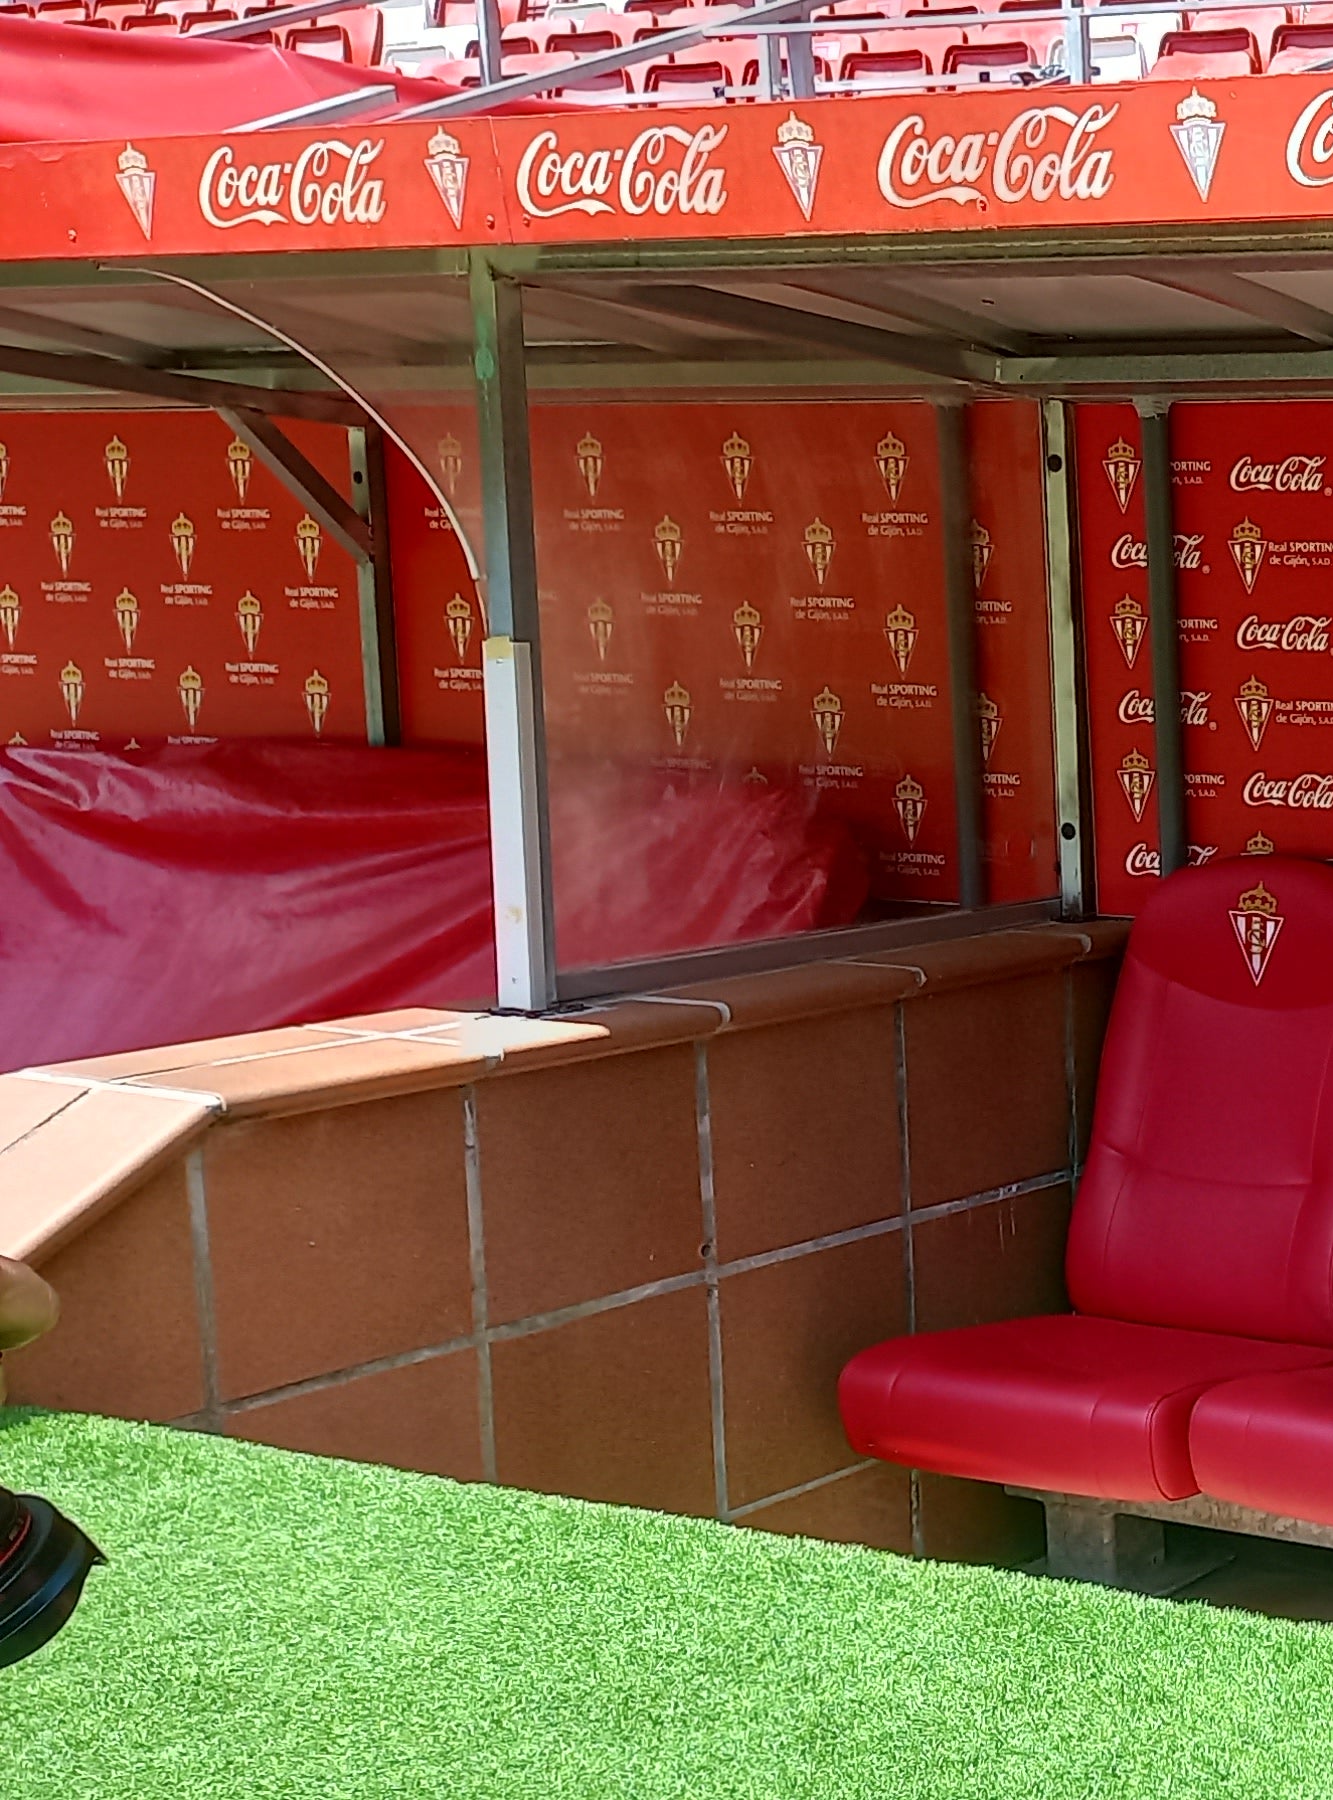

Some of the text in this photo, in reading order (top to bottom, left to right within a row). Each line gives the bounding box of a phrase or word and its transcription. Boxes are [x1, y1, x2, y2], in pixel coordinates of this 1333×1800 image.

[517, 123, 729, 217] Coca-Cola
[876, 101, 1121, 208] Coca-Cola
[200, 138, 387, 228] Coca-Cola
[1230, 456, 1326, 491] Coca-Cola
[880, 513, 928, 524] SPORTING
[807, 598, 854, 609] SPORTING
[1237, 616, 1332, 651] Coca-Cola
[889, 684, 937, 696] SPORTING
